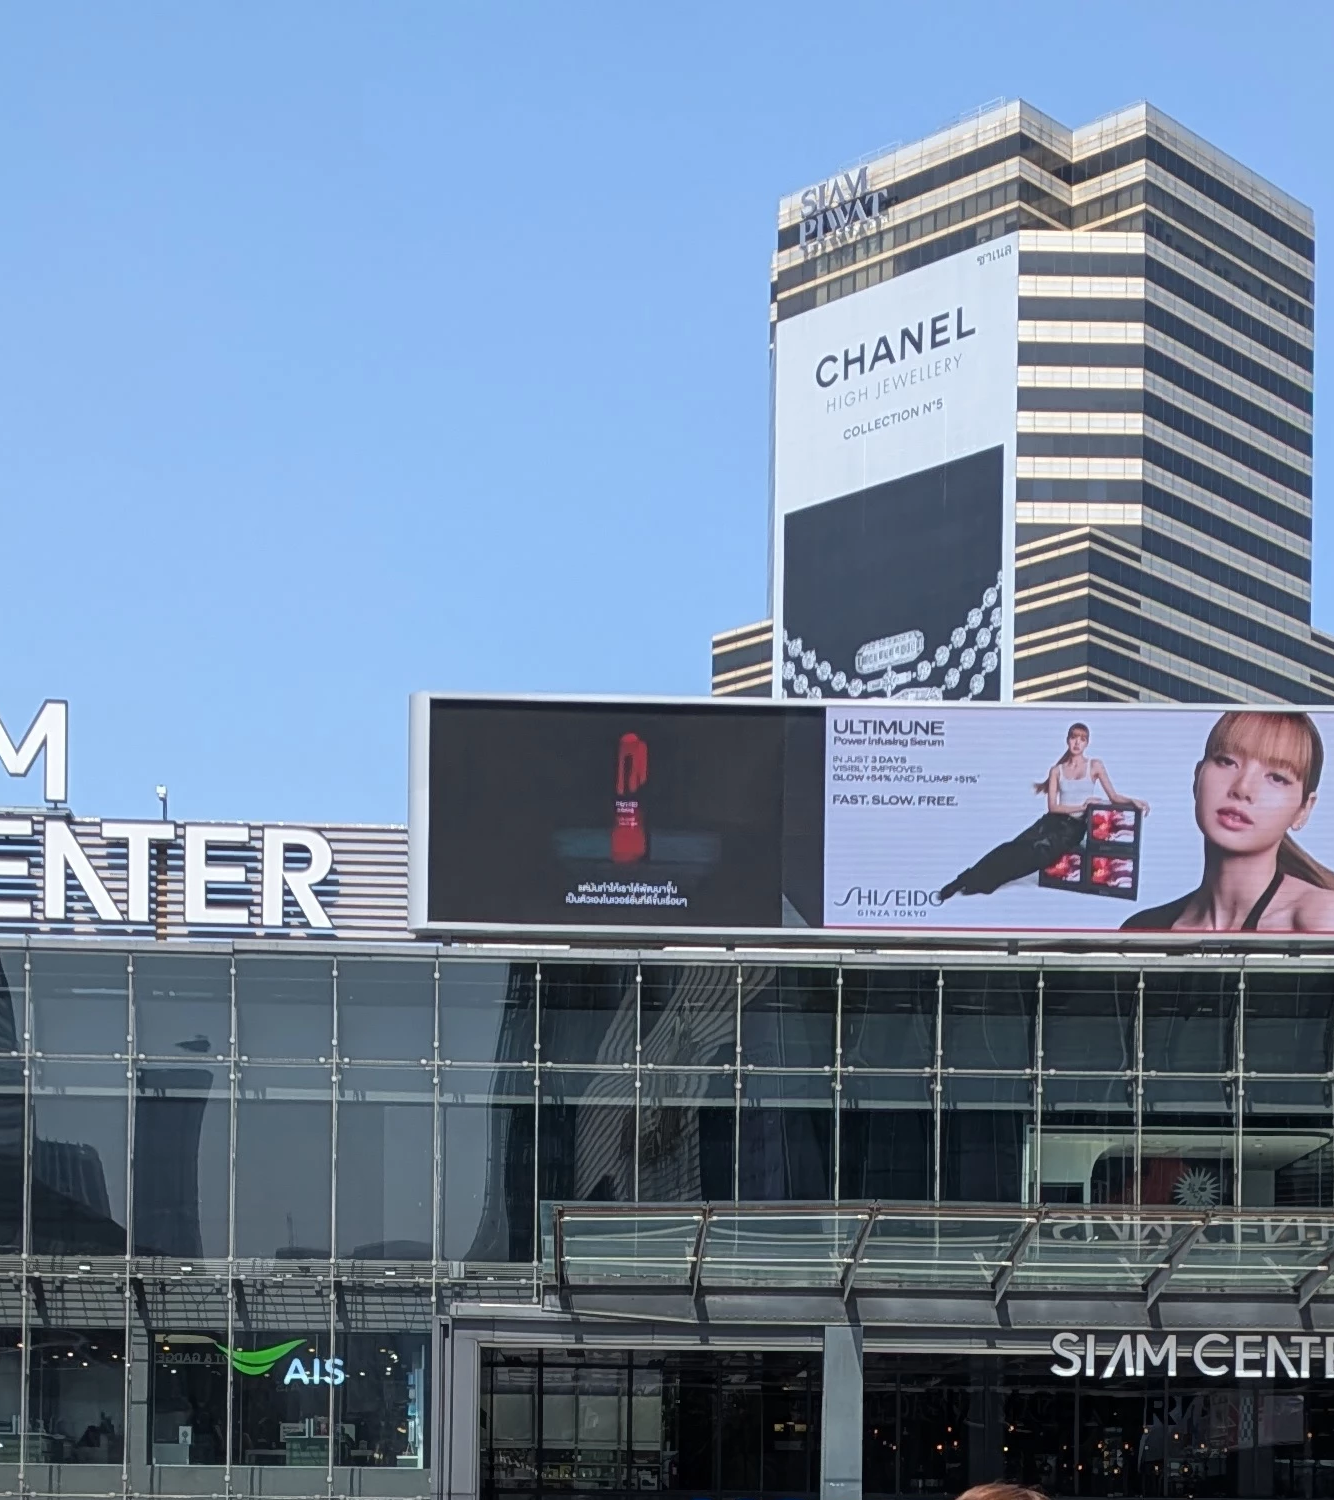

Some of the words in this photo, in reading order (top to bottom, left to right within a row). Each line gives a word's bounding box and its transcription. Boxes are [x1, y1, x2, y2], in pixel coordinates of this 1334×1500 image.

[799, 166, 868, 217] SIAM
[798, 188, 888, 245] PIWAT
[815, 306, 976, 389] CHANEL
[825, 385, 869, 414] HIGH
[875, 353, 964, 402] JEWELLERY
[842, 405, 920, 441] COLLECTION
[833, 719, 945, 736] ULTIMUNE
[833, 736, 866, 746] Power
[868, 736, 909, 748] Infusing
[910, 737, 945, 747] Serum
[871, 756, 877, 764] 3
[878, 756, 907, 764] DAYS
[833, 774, 864, 782] GLOW
[893, 775, 915, 783] AND
[832, 794, 870, 806] FAST.
[872, 795, 915, 806] SLOW.
[918, 795, 958, 807] FREE.
[833, 886, 945, 907] SHISEIDO
[857, 909, 890, 917] GINZA
[893, 910, 927, 918] TOKYO
[1050, 1332, 1178, 1379] SIAM
[283, 1357, 347, 1386] AIS
